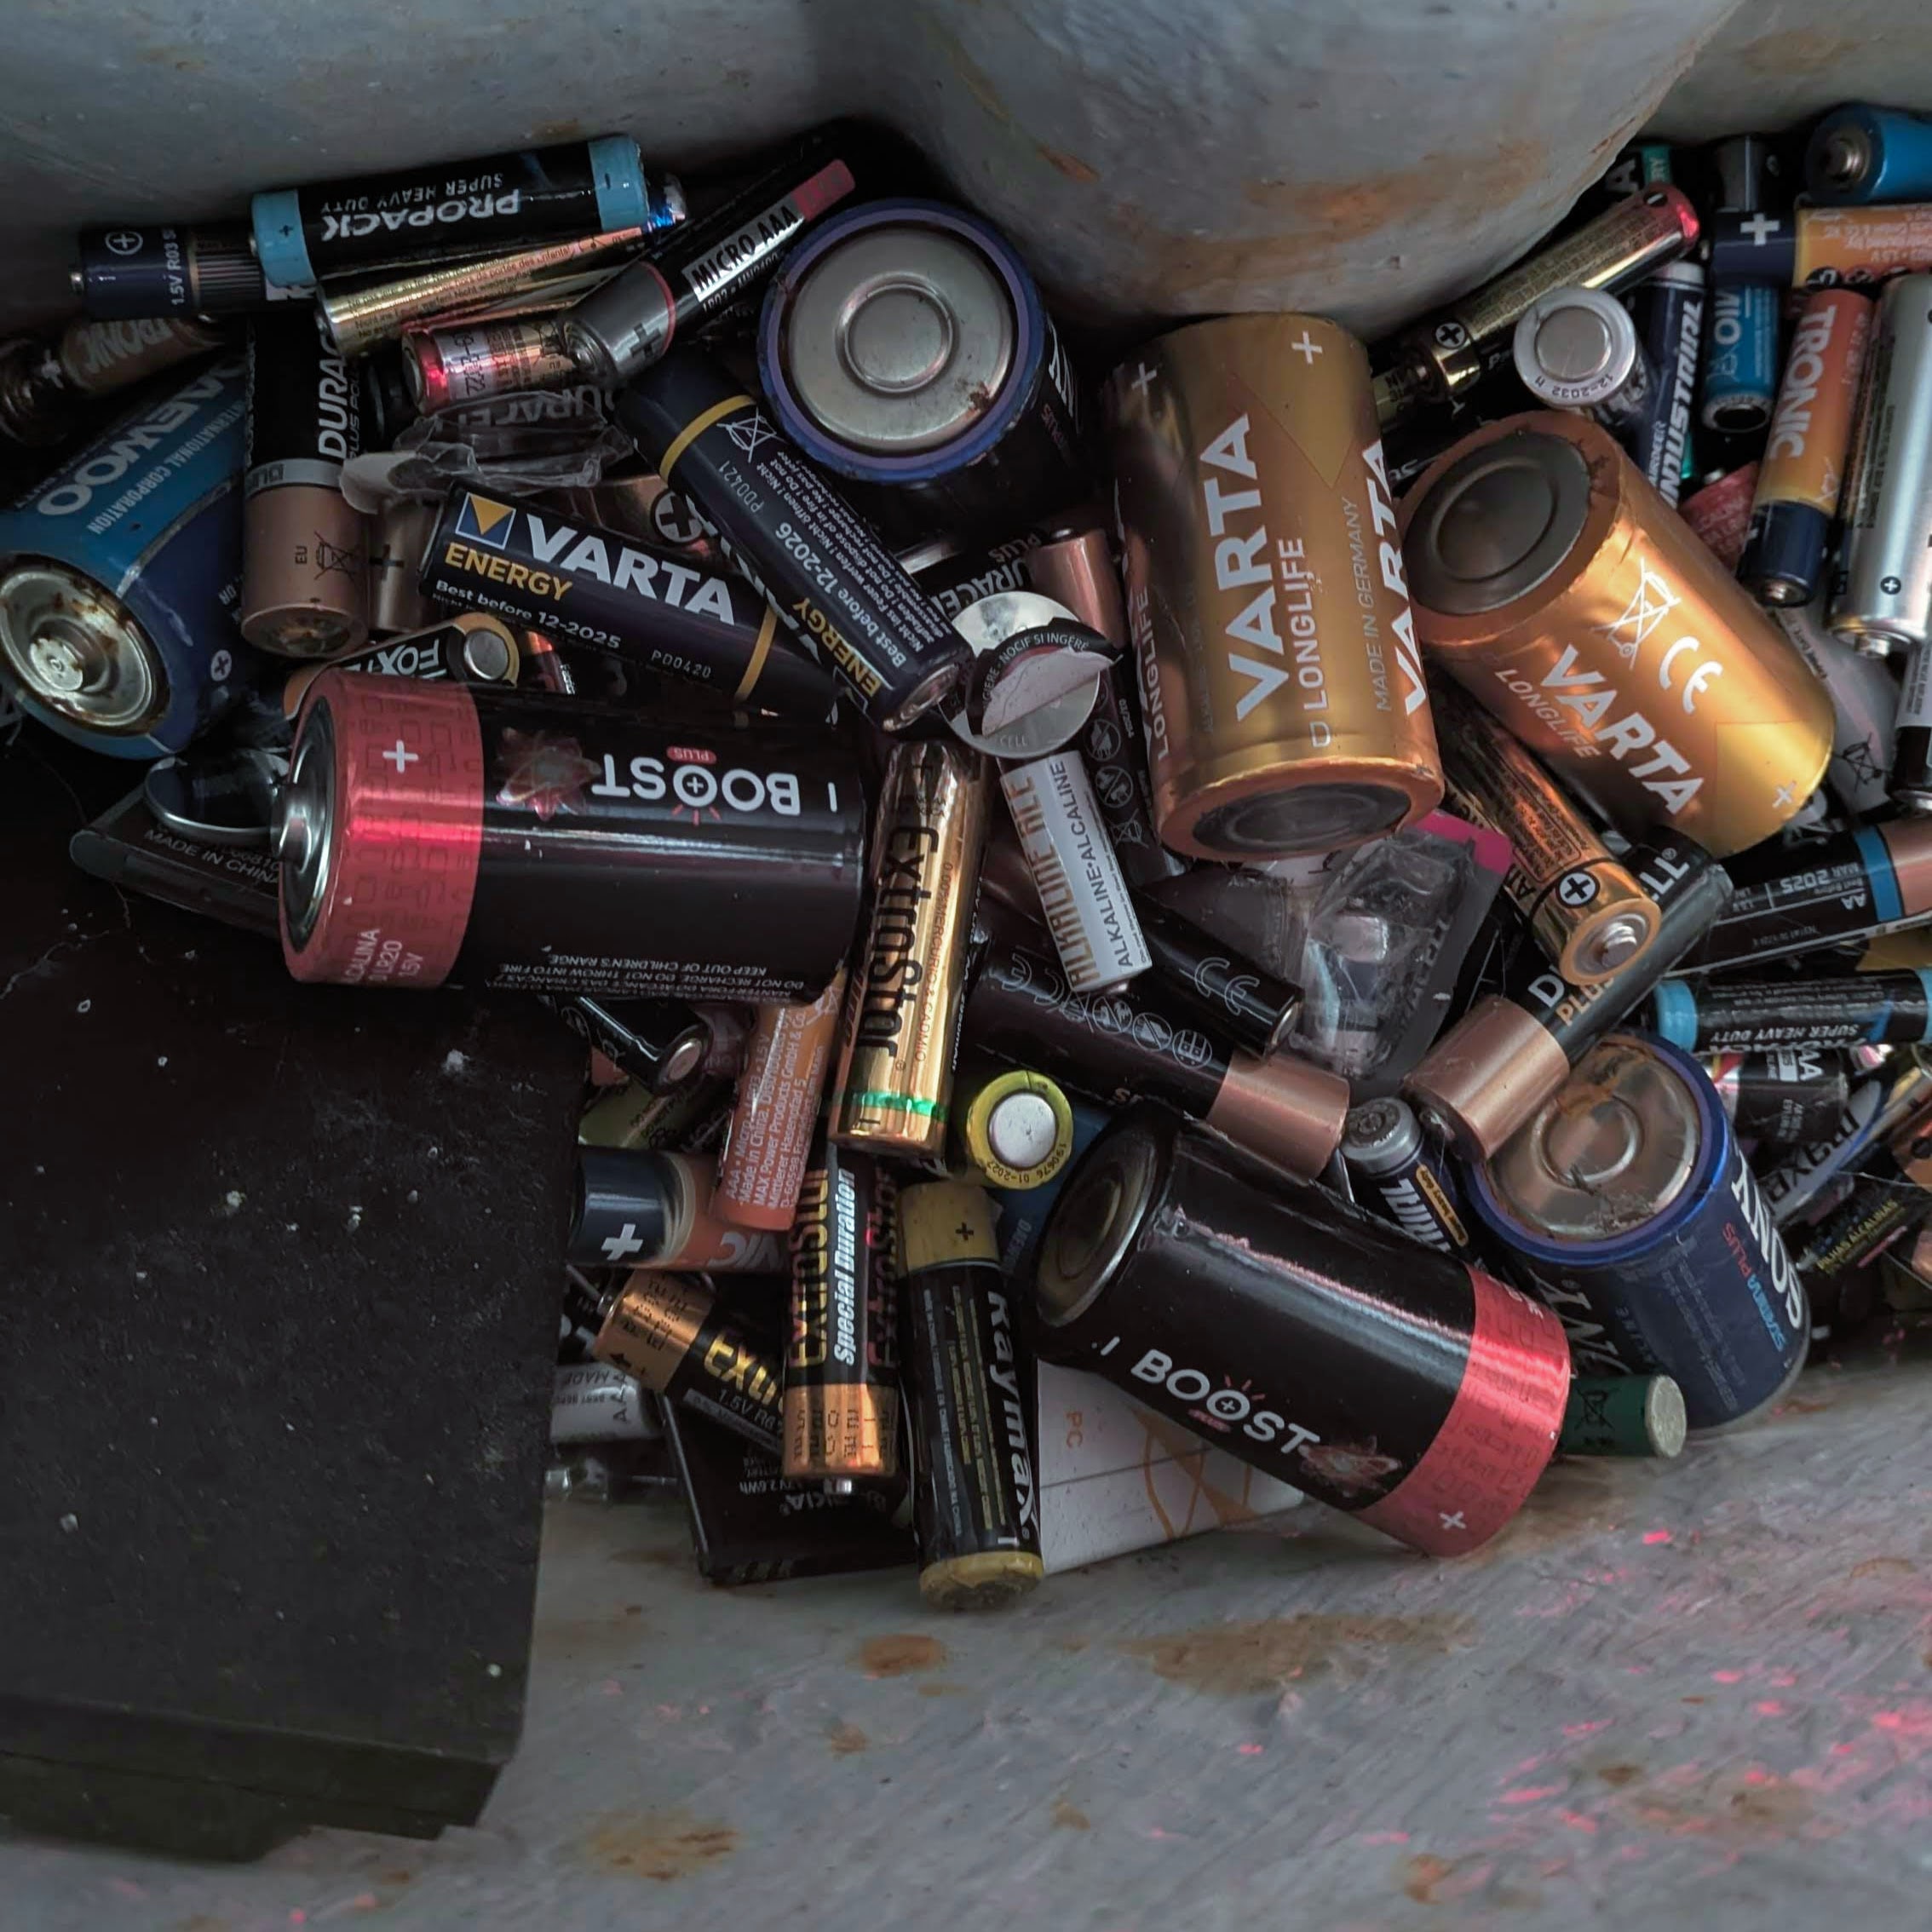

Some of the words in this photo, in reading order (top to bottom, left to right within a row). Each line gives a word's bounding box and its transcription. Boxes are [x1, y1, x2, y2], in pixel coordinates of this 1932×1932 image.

[320, 197, 370, 214] DUTY
[377, 187, 437, 210] HEAVY
[446, 172, 504, 196] SUPER
[320, 188, 520, 241] PROPACK
[691, 233, 756, 290] MICRO
[757, 204, 799, 245] AAA
[1552, 373, 1612, 398] 12-2032
[1659, 299, 1704, 509] INDUSTRIAL
[1769, 304, 1837, 460] TRONIC
[86, 462, 173, 537] CORPORATION
[754, 460, 783, 490] Nicht
[295, 545, 308, 565] EU
[771, 519, 842, 596] 12-2026
[806, 519, 835, 549] Nicht
[1342, 497, 1377, 608] GERMANY
[444, 542, 575, 602] ENERGY
[525, 512, 735, 627] VARTA
[1198, 411, 1290, 722] VARTA
[1362, 439, 1427, 716] VARTA
[435, 579, 474, 602] Best
[477, 589, 533, 621] before
[537, 610, 623, 650] 12-2025
[830, 585, 880, 640] before
[1278, 538, 1329, 711] LONGLIFE
[1363, 616, 1379, 641] IN
[376, 638, 440, 677] FOX
[791, 596, 882, 699] ENERGY
[872, 632, 907, 670] Best
[1134, 586, 1170, 762] LONGLIFE
[1368, 659, 1392, 712] MADE
[1494, 667, 1601, 759] LONGLIFE
[1308, 720, 1333, 749] D
[1540, 642, 1705, 815] VARTA
[590, 752, 802, 816] BOOST
[143, 827, 198, 859] MADE
[201, 846, 223, 868] IN
[1780, 869, 1831, 894] 2025
[1710, 1027, 1751, 1044] DUTY
[1754, 1024, 1806, 1041] HEAVY
[1808, 1023, 1860, 1038] SUPER
[836, 1166, 857, 1262] Duration
[833, 1262, 855, 1368] Special
[1130, 1347, 1321, 1454] BOOST
[1065, 1411, 1084, 1448] PC
